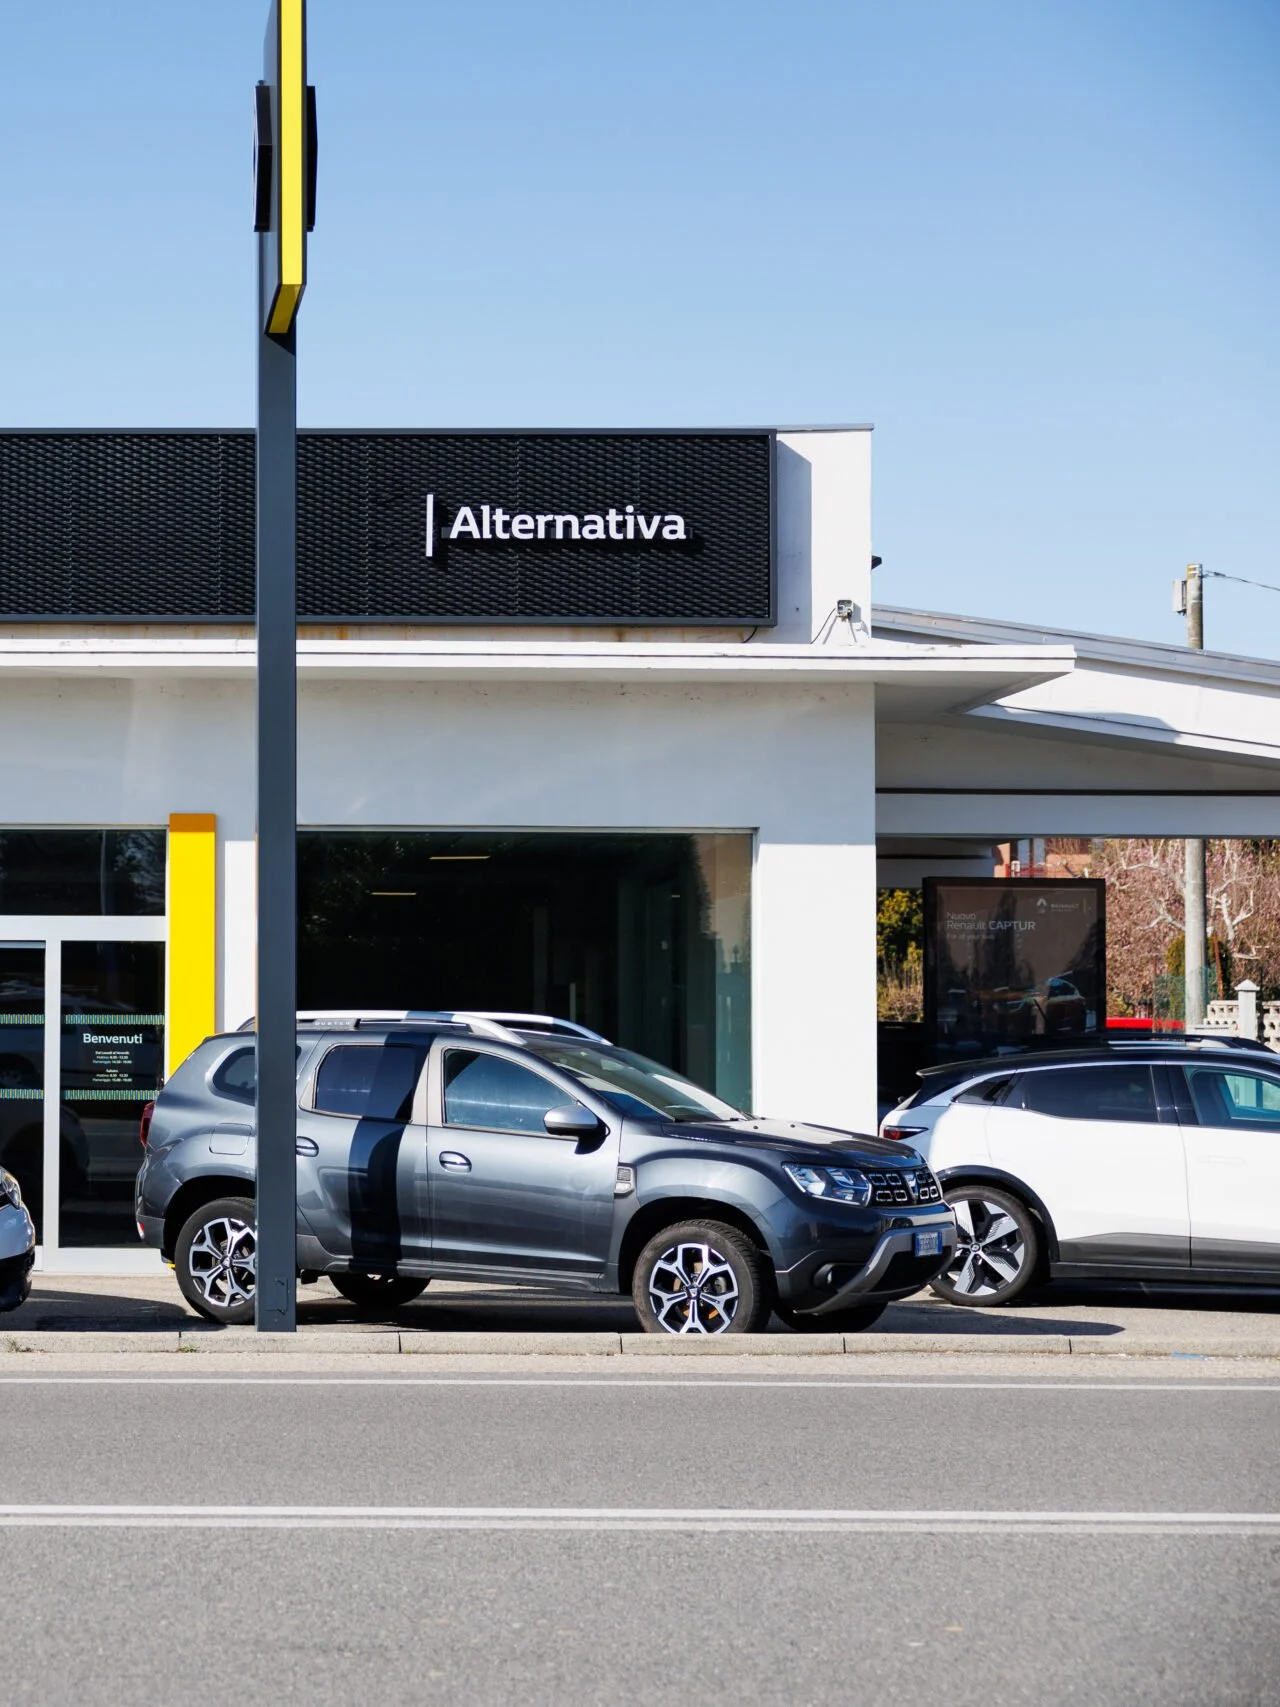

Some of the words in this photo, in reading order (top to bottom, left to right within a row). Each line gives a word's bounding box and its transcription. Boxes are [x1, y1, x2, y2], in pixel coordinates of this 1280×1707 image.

[449, 505, 686, 540] Alternativa
[946, 912, 976, 920] Nuovo
[946, 920, 986, 931] Renault
[988, 921, 1036, 931] CAPTUR
[82, 1033, 143, 1044] Benvenuti
